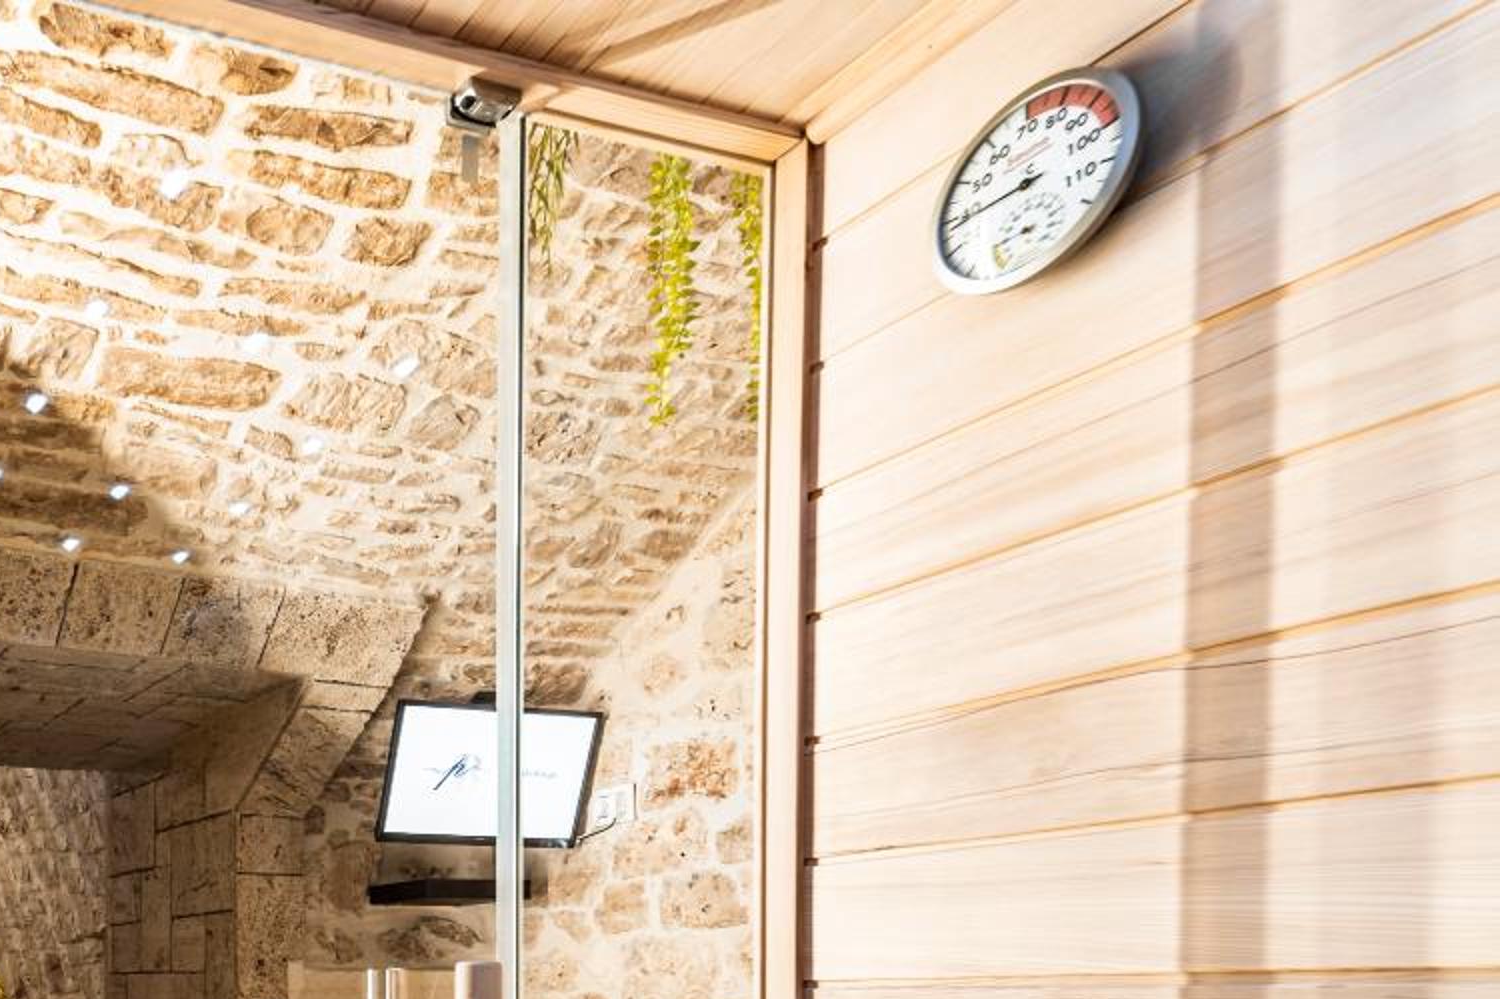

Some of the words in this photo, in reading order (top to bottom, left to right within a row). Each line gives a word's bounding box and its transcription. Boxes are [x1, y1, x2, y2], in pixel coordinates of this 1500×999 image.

[1045, 107, 1067, 129] 80
[1016, 119, 1038, 140] 70
[1068, 128, 1101, 156] 100
[989, 144, 1011, 166] 60
[972, 172, 993, 193] 50
[1066, 161, 1097, 188] 110
